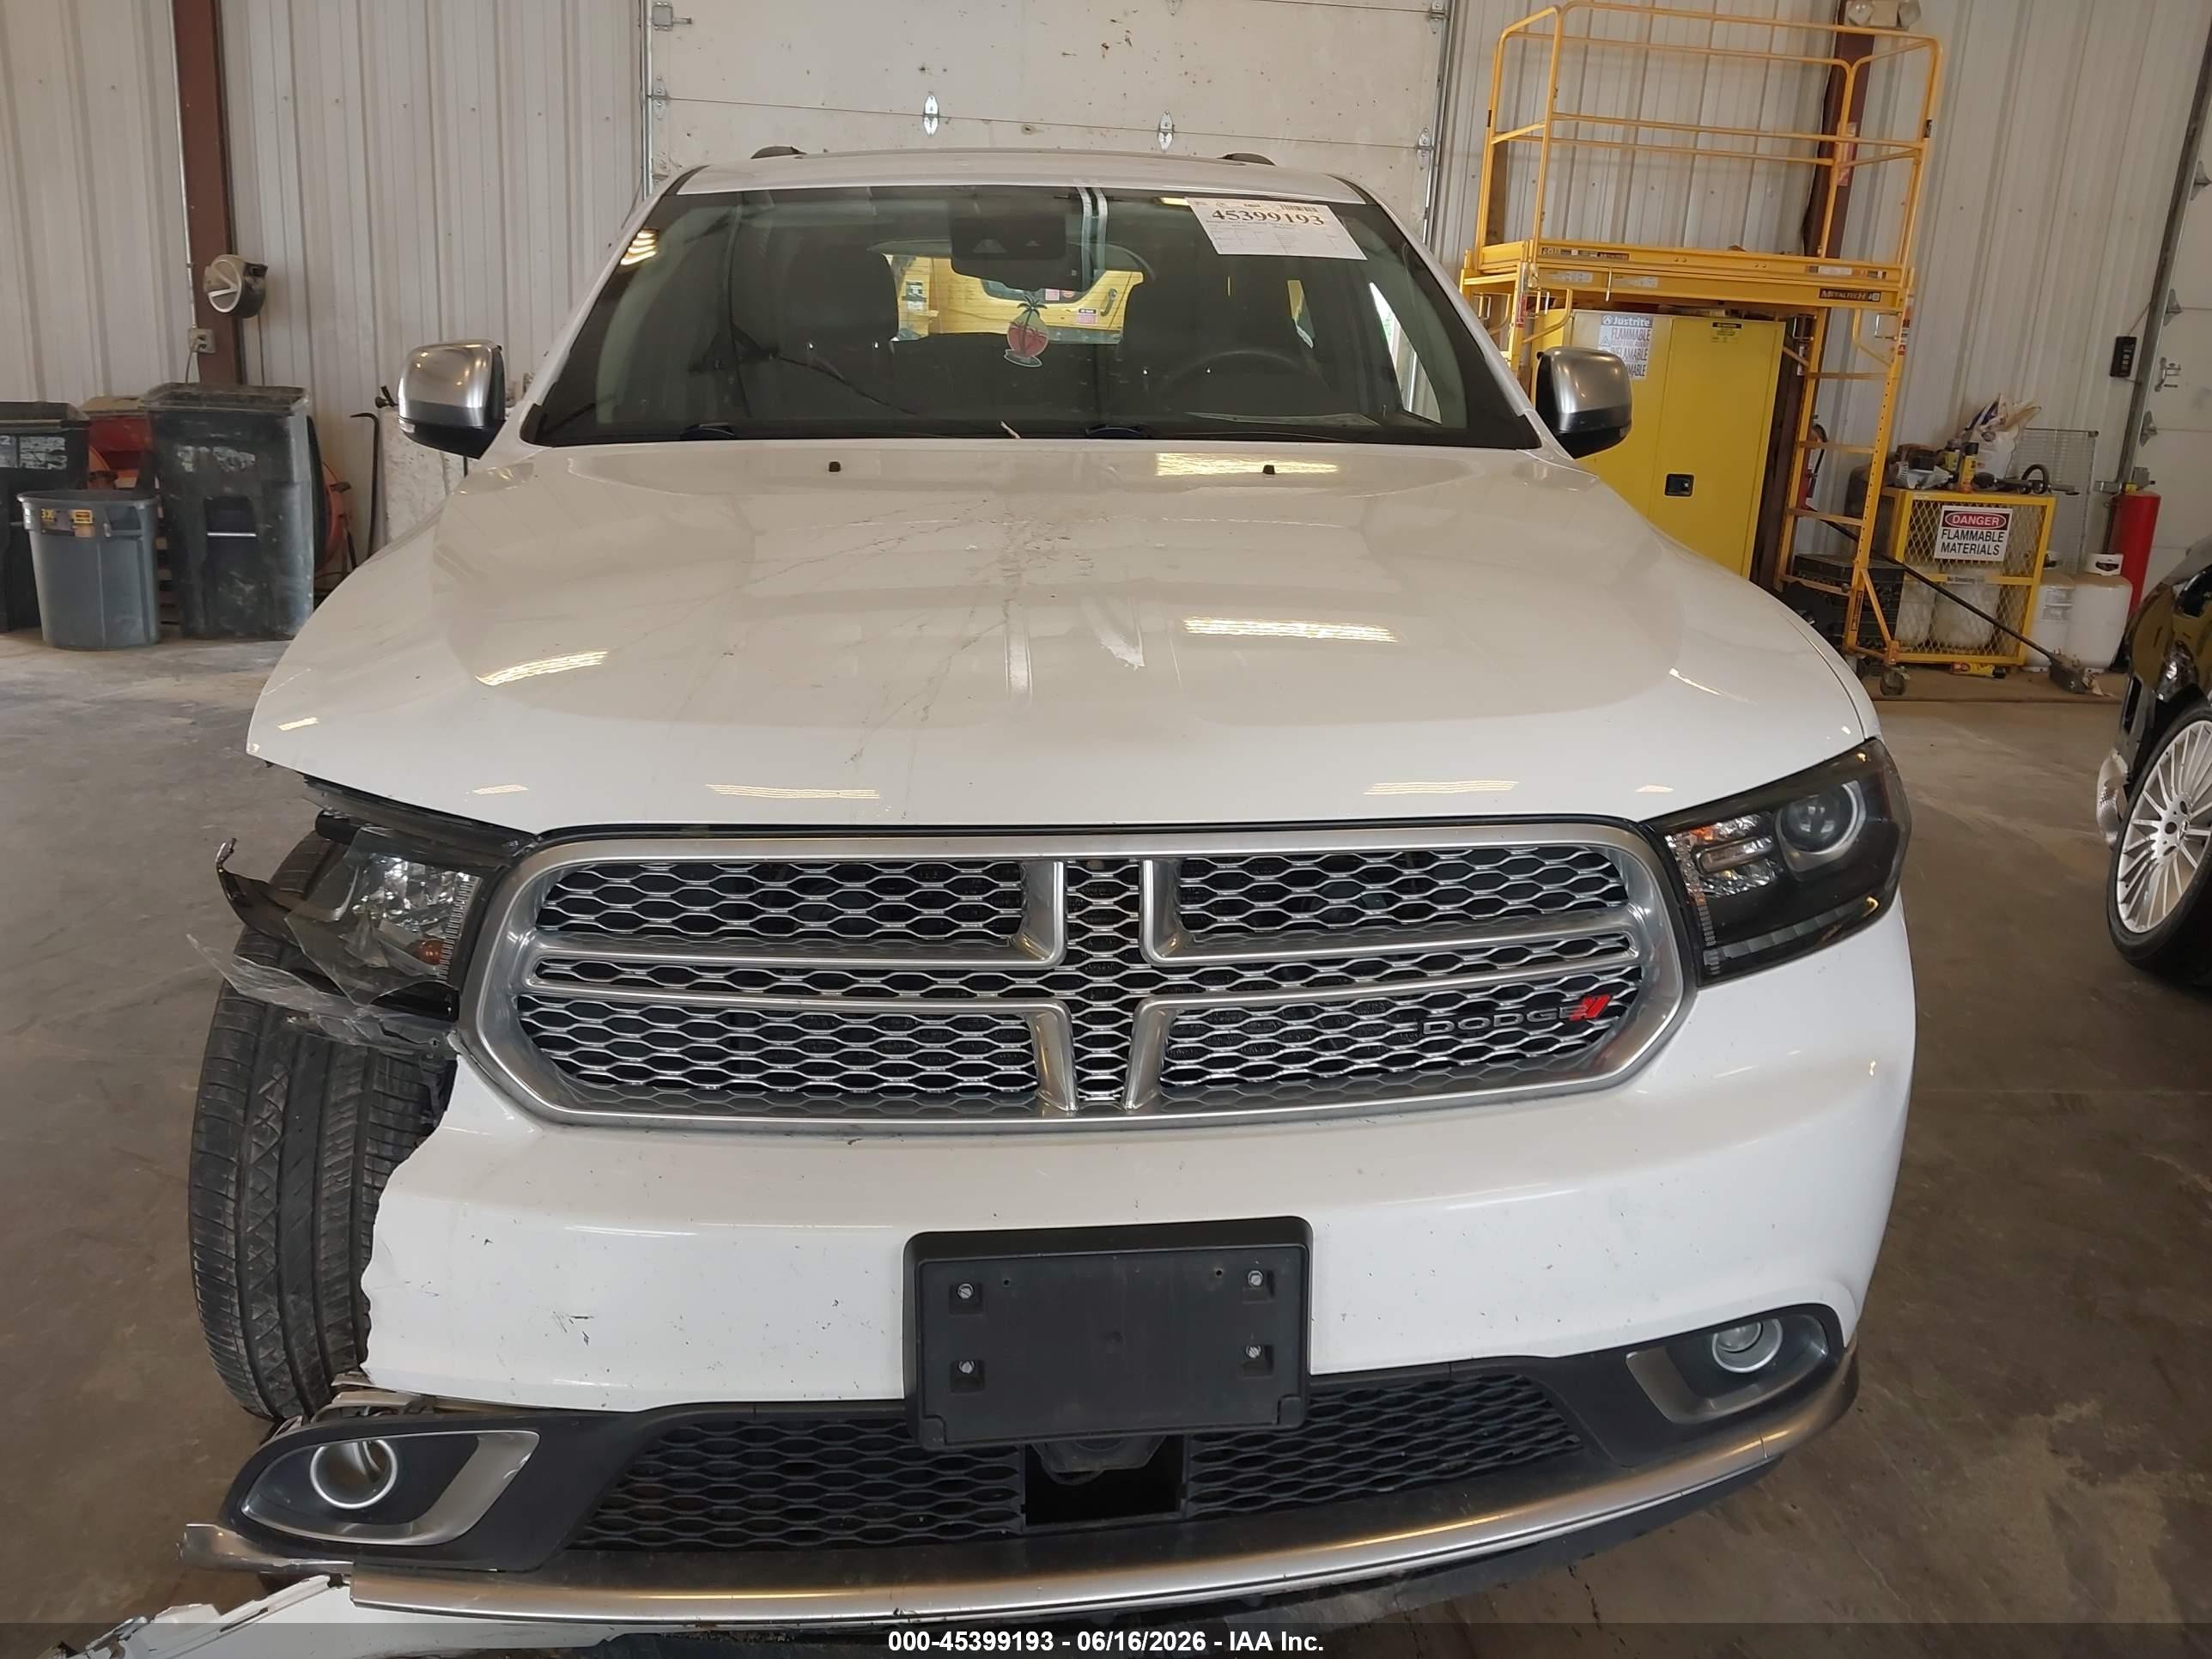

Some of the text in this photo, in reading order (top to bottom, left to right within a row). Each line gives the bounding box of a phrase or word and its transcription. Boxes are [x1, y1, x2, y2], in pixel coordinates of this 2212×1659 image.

[1212, 210, 1325, 226] 45399193
[1613, 317, 1650, 326] Justrite
[1612, 328, 1650, 341] FLAMMABLE
[1952, 514, 2000, 526] DANGER
[1941, 529, 2005, 543] FLAMMABLE
[1941, 543, 2000, 556] MATERIALS
[1423, 1004, 1582, 1036] DODGE
